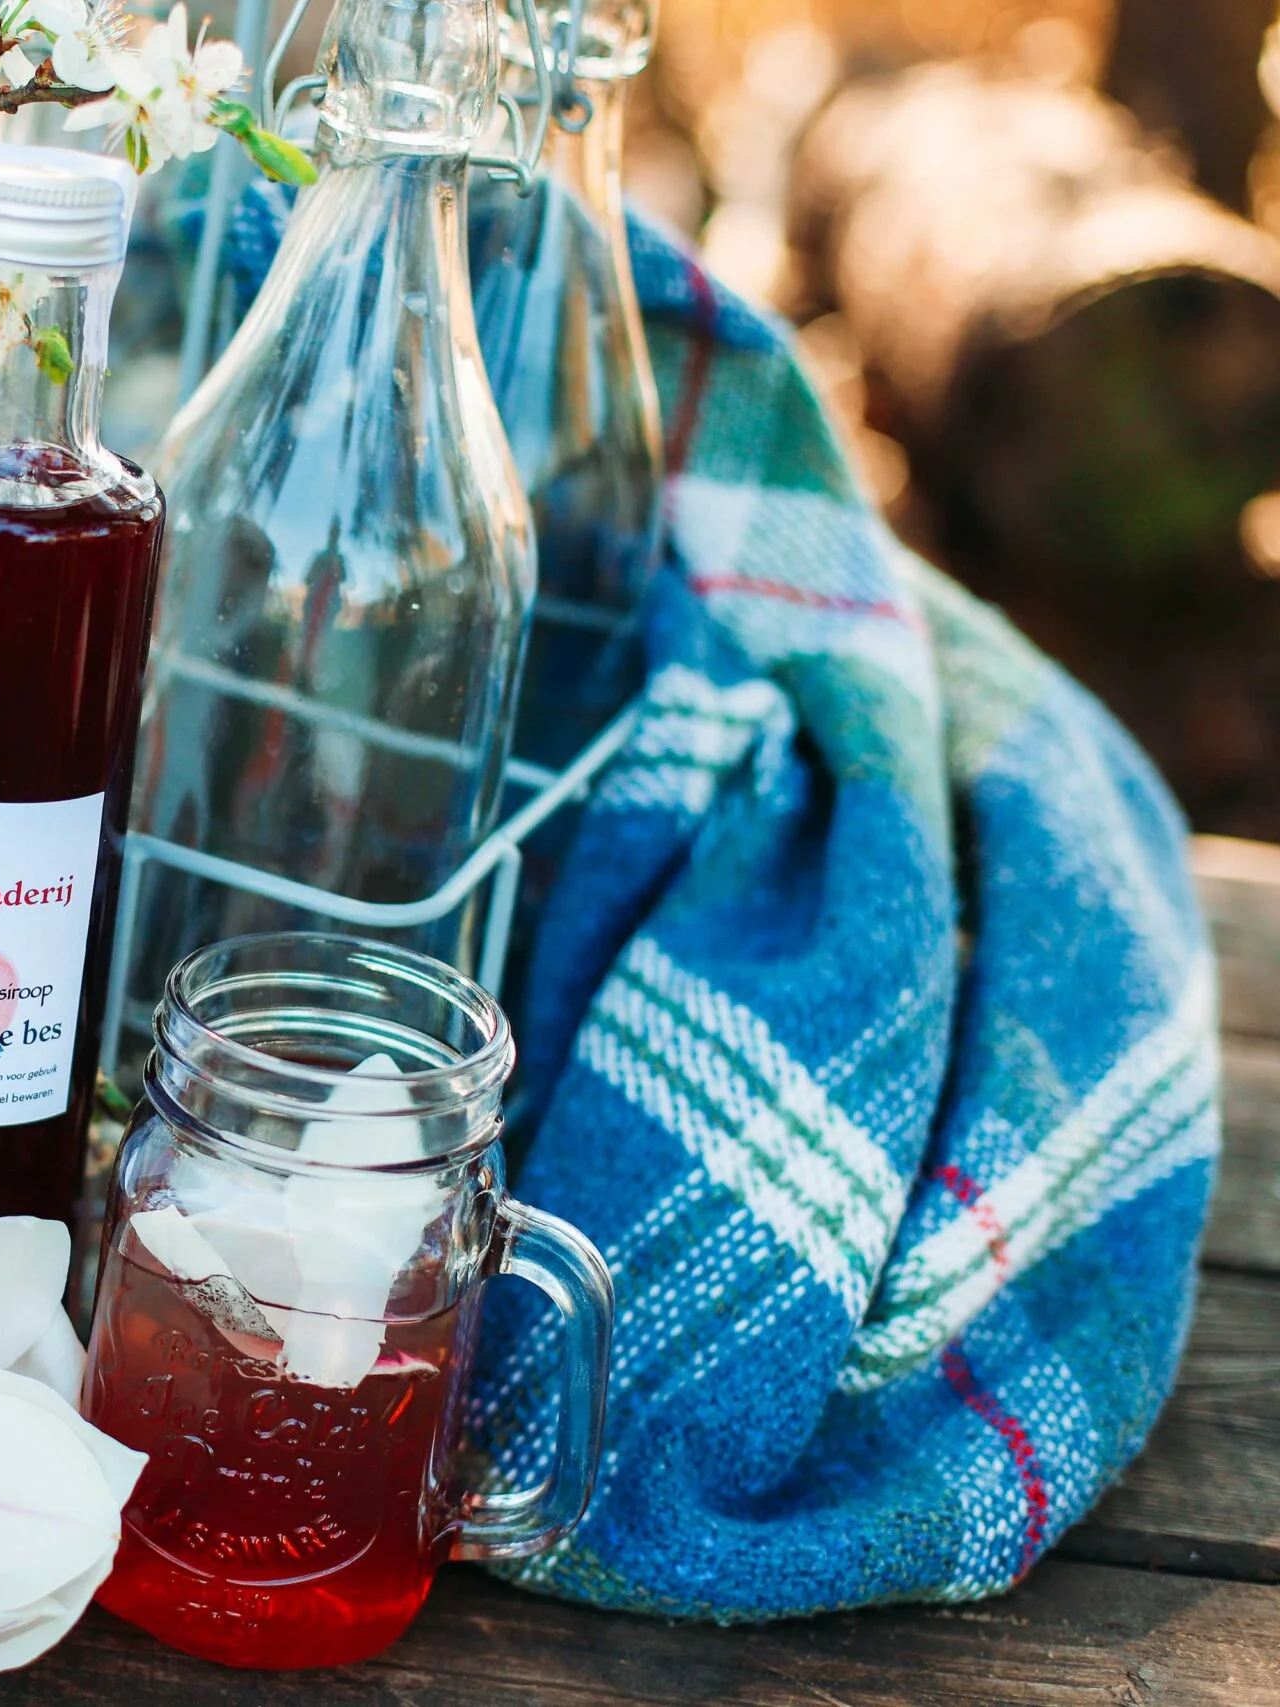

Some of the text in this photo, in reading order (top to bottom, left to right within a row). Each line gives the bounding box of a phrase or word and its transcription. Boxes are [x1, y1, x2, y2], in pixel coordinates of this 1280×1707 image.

[23, 1017, 63, 1046] bes
[6, 1073, 26, 1081] voor
[27, 1064, 58, 1081] gebruik
[11, 1087, 53, 1103] bewaren
